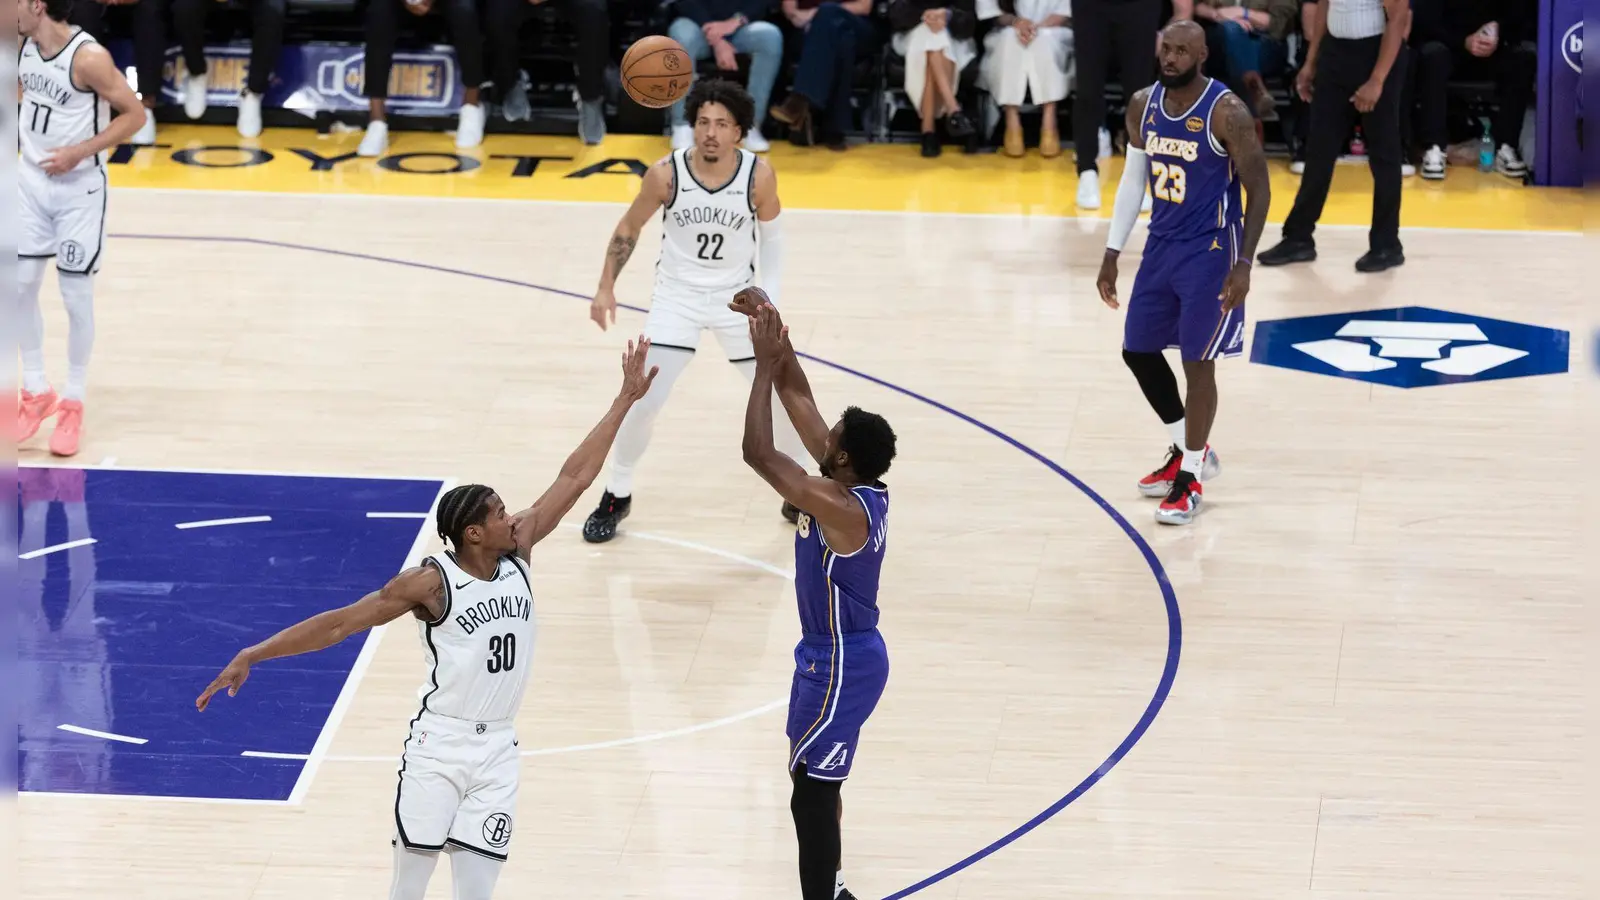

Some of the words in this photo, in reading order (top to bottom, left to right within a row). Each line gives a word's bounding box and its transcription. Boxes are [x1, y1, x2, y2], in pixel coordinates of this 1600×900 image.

[31, 101, 52, 134] 77
[107, 143, 649, 178] TOYOTA
[1145, 130, 1199, 162] LAKERS
[1151, 161, 1187, 204] 23
[673, 206, 747, 231] BROOKLYN
[697, 233, 724, 260] 22
[456, 596, 531, 635] BROOKLYN
[487, 633, 516, 673] 30
[813, 741, 848, 770] LA
